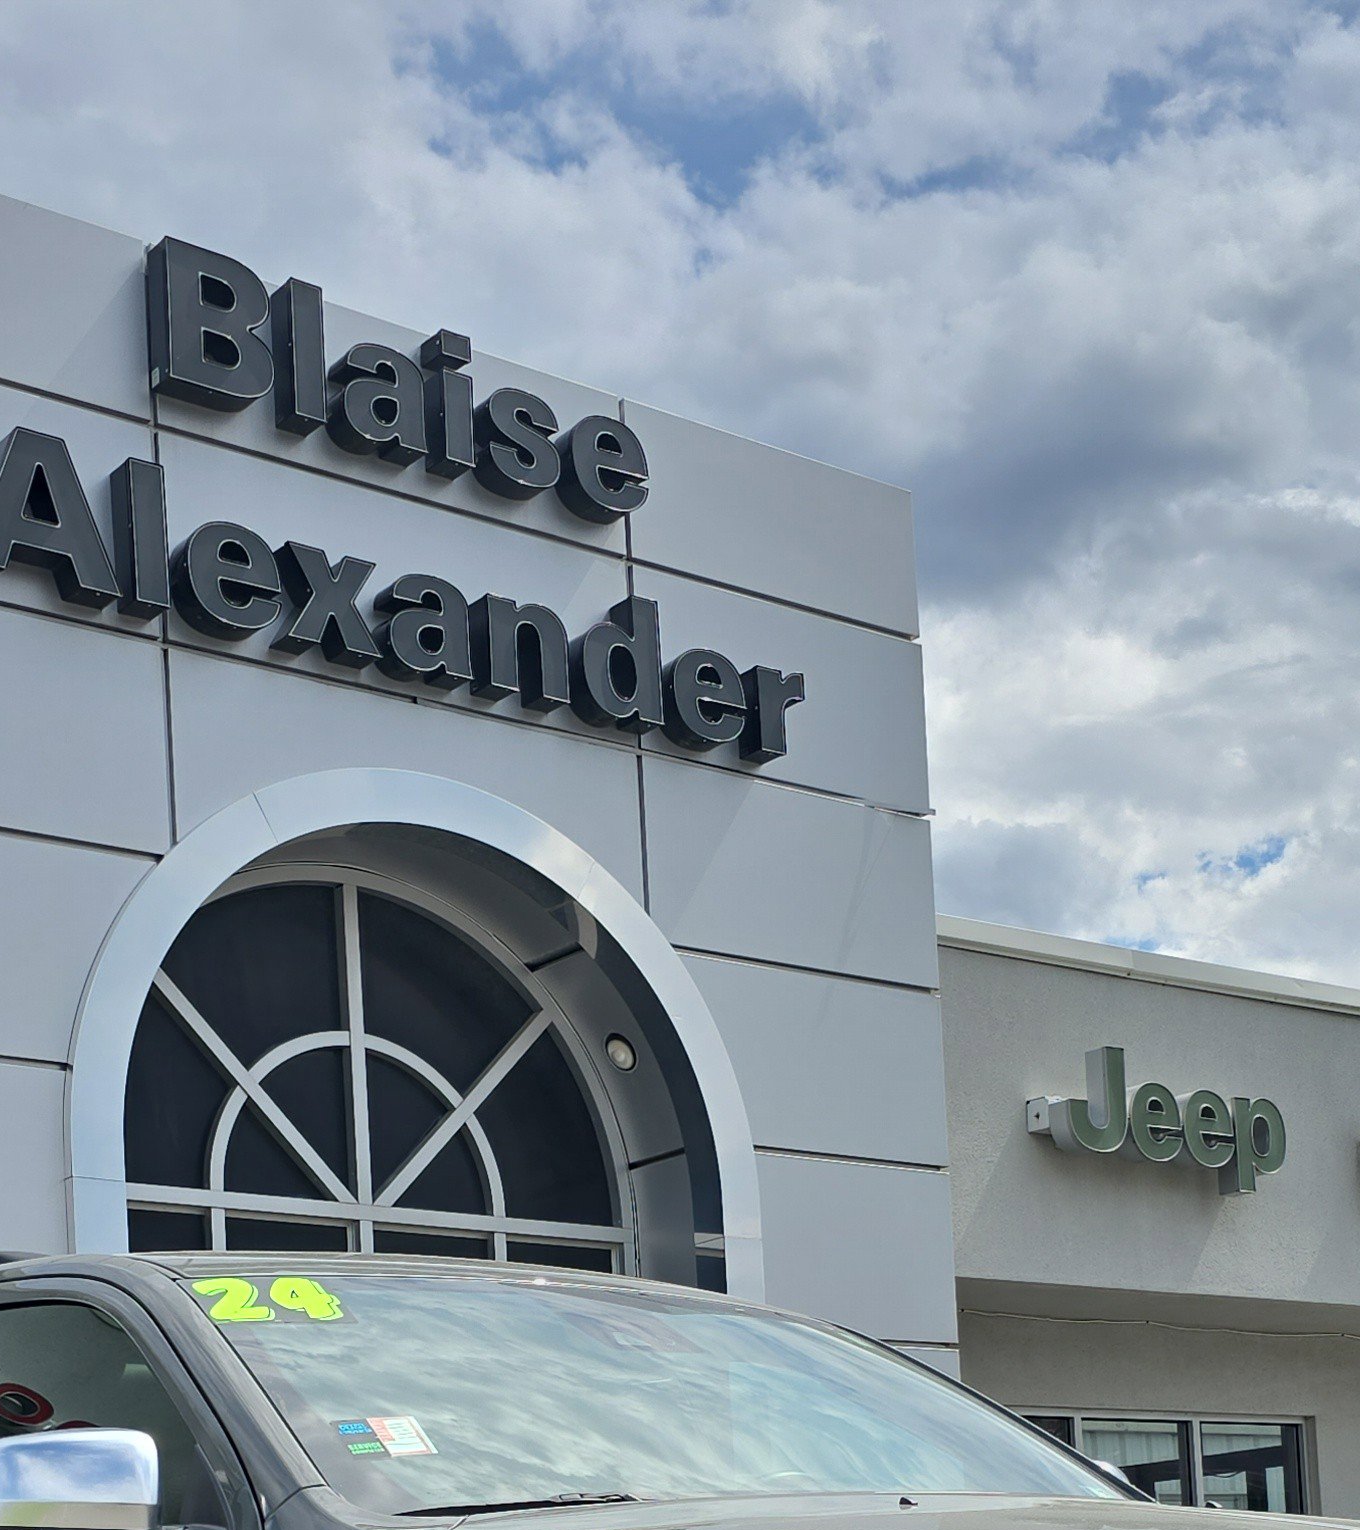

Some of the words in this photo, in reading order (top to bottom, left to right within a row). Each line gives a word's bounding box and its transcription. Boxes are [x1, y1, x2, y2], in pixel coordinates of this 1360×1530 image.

[146, 235, 650, 525] Blaise
[1048, 1045, 1286, 1196] Jeep
[191, 1277, 344, 1322] 24
